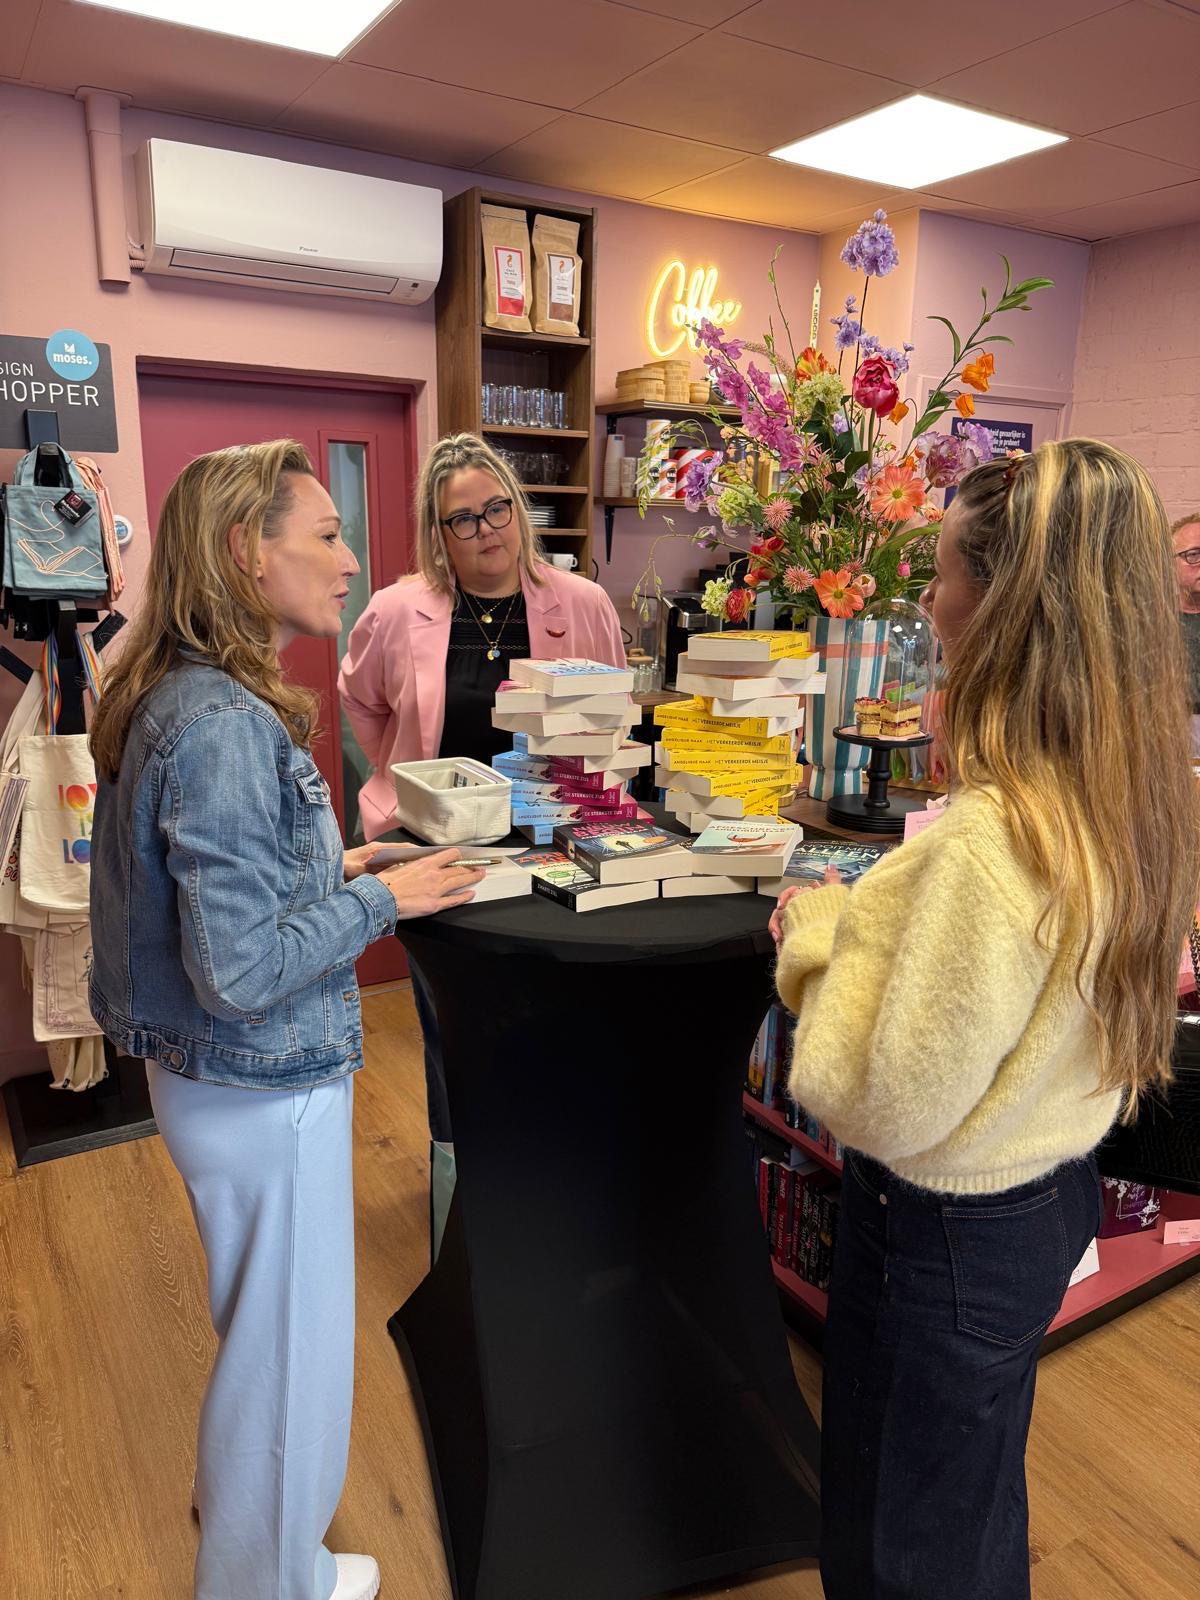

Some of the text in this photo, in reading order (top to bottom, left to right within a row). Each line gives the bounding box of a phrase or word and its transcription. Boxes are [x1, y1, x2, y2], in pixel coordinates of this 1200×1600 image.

[646, 260, 742, 357] Coffee
[53, 353, 93, 365] moses.
[0, 380, 99, 406] HOPPER
[700, 719, 726, 727] VERKEERDE
[794, 847, 880, 860] ALLEEN
